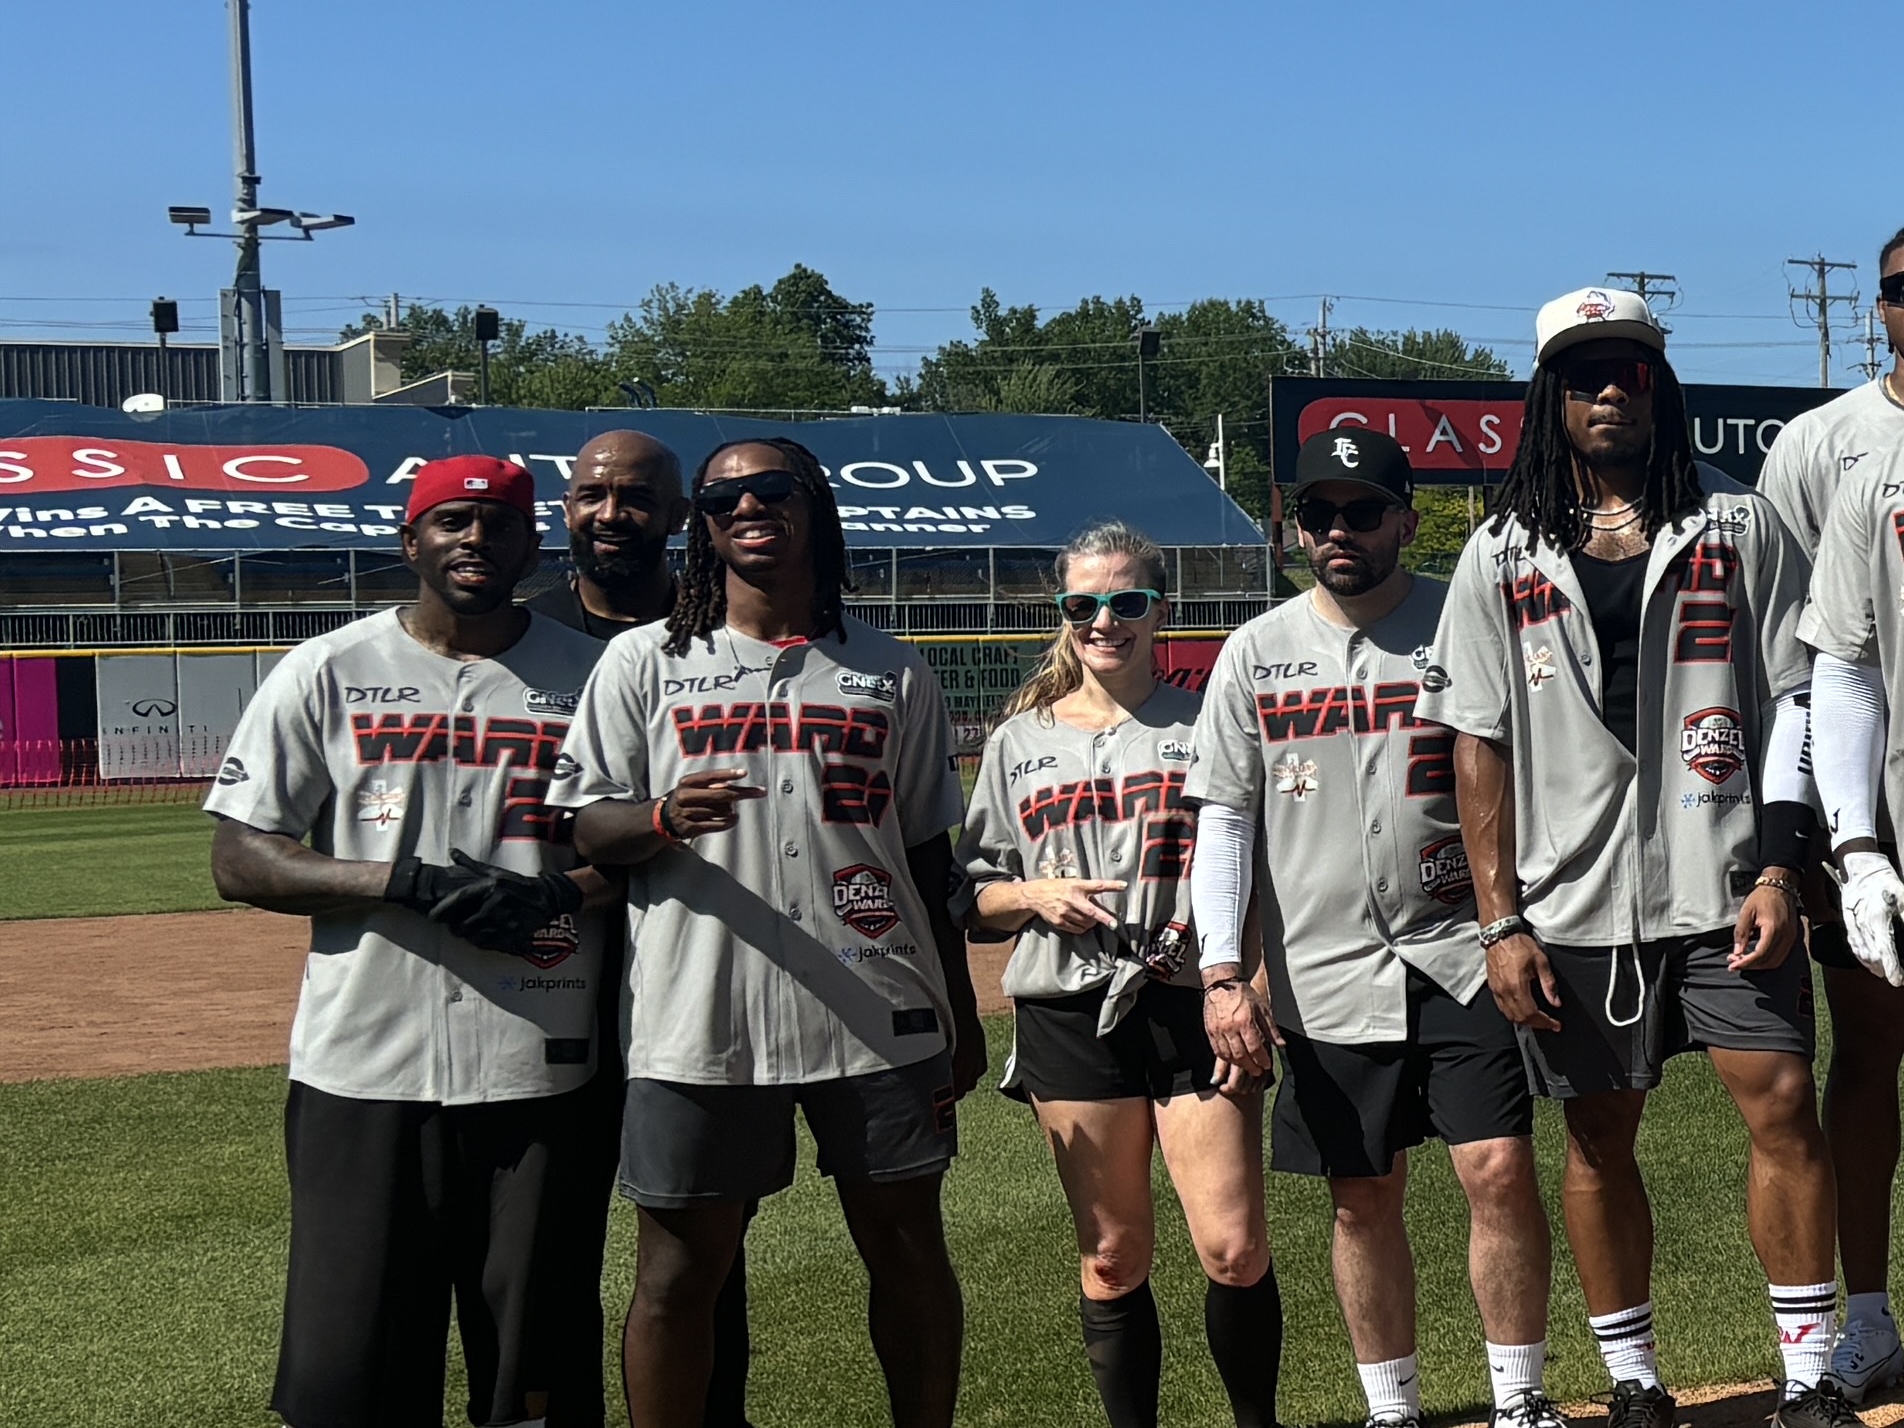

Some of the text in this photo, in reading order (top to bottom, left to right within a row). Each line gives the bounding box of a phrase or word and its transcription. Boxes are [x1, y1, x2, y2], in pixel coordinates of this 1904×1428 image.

[1693, 417, 1787, 456] UTO
[826, 459, 1038, 489] OUP
[0, 504, 109, 524] ins
[121, 495, 175, 516] A
[184, 498, 356, 520] FREE
[838, 504, 1037, 521] PTAINS
[0, 515, 262, 538] hen The
[838, 521, 992, 534] anner
[1252, 661, 1319, 680] DTLR
[345, 686, 422, 705] DTLR
[1254, 679, 1426, 744] WAR
[102, 724, 208, 735] INFINTI
[671, 702, 892, 759] WARD
[1680, 725, 1746, 751] DENZEL
[857, 943, 916, 964] jakprints
[519, 975, 587, 993] jakprints
